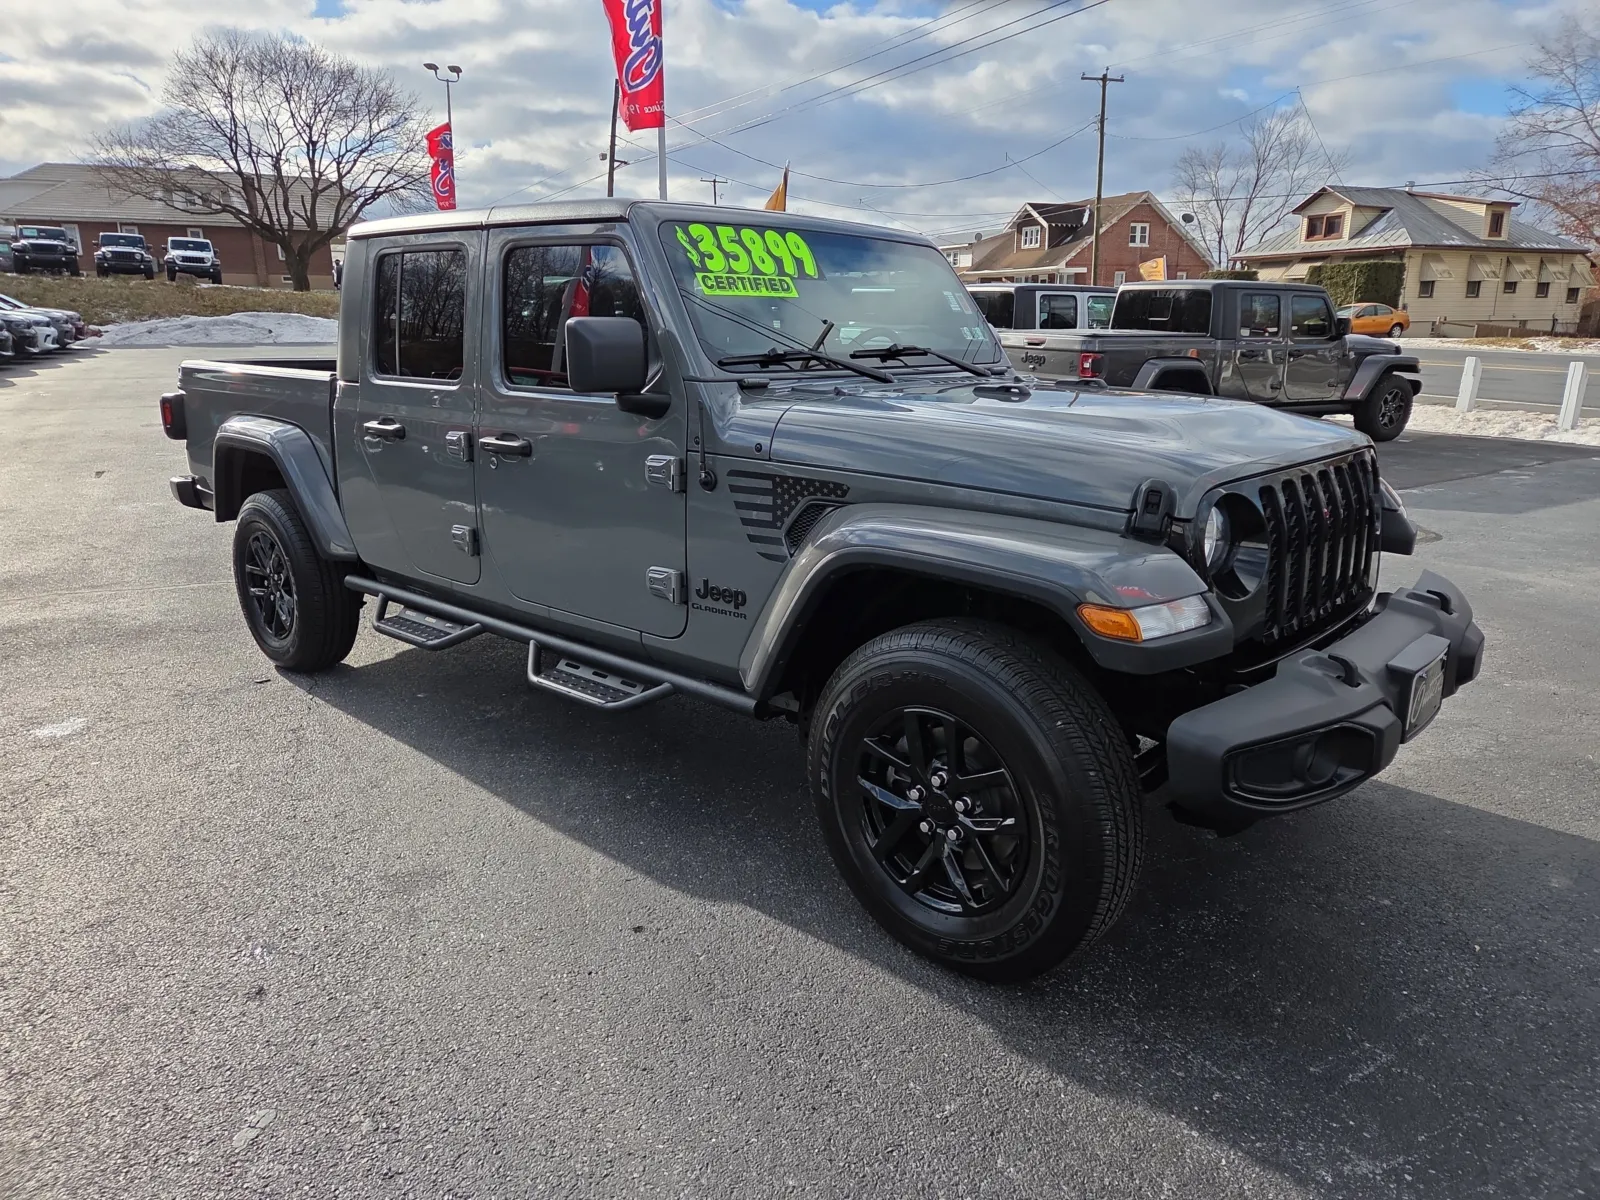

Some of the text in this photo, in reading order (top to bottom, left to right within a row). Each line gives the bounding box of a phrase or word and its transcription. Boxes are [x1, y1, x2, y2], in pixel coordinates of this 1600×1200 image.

[675, 223, 818, 279] $35899
[701, 275, 793, 293] CERTIFIED
[1021, 351, 1046, 366] Jeep
[695, 577, 747, 610] Jeep
[691, 602, 748, 620] GLADIATOR
